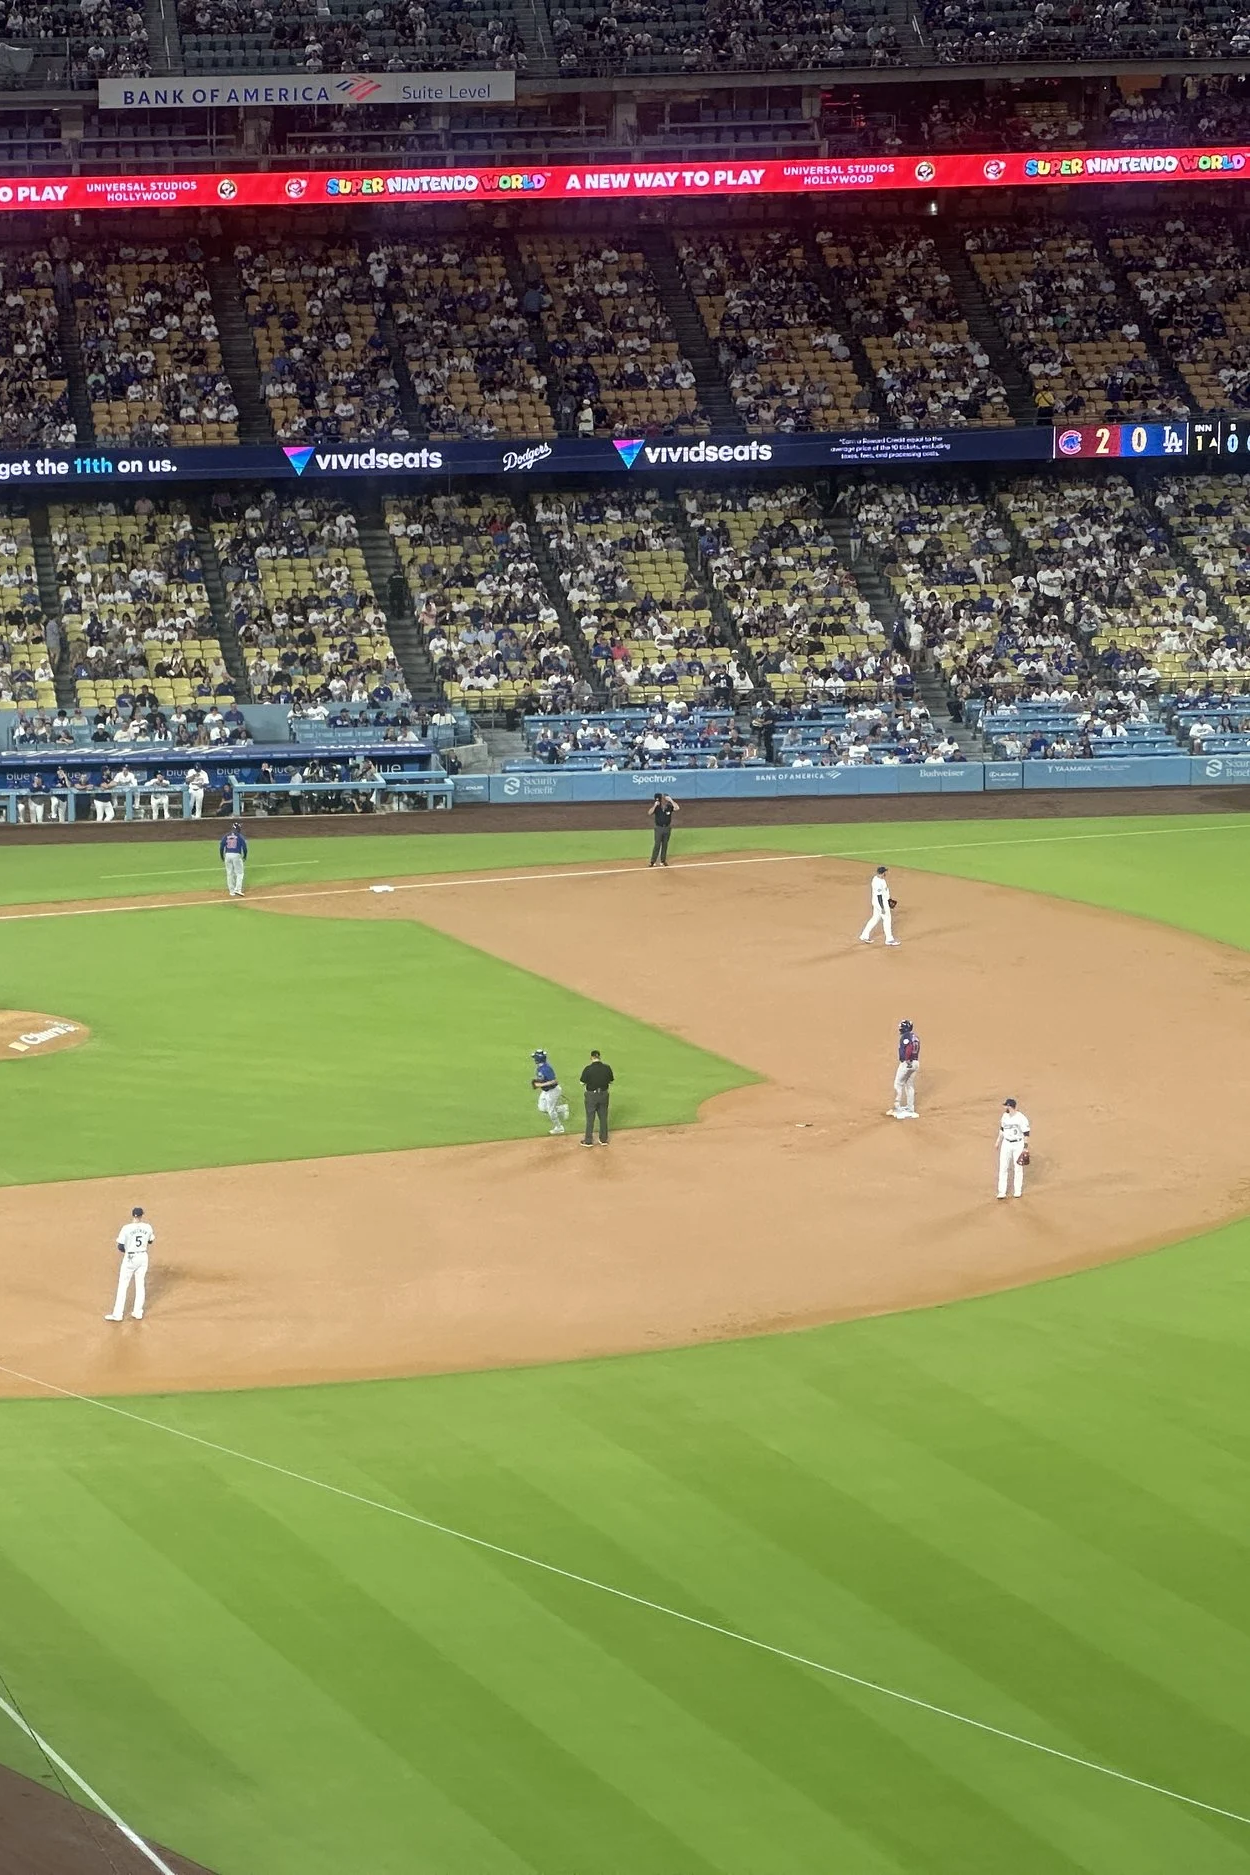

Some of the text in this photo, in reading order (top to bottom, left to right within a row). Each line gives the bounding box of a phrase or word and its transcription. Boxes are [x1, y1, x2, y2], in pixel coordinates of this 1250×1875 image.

[123, 86, 330, 105] BANK OF AMERICA
[402, 84, 490, 99] Suite Level
[783, 164, 895, 177] UNIVERSAL STUDIOS
[1024, 158, 1083, 177] SUPER
[1085, 155, 1178, 175] NINTENDO
[326, 177, 385, 196] SUPER
[387, 175, 479, 194] NINTENDO
[565, 168, 765, 189] A NEW WAY TO PLAY
[803, 174, 874, 185] HOLLYWOOD
[18, 185, 69, 201] PLAY
[86, 180, 197, 193] UNIVERSAL STUDIOS
[107, 191, 177, 201] HOLLYWOOD
[1194, 424, 1213, 433] INN
[1230, 423, 1237, 432] B
[1095, 428, 1111, 454] 2
[1131, 426, 1147, 453] 0
[1163, 425, 1183, 453] LA
[1195, 435, 1204, 451] 1
[1227, 433, 1239, 453] 0
[315, 447, 442, 470] vividseats
[502, 442, 552, 472] Dodgers
[644, 440, 773, 464] vividseats
[35, 457, 69, 475] the
[73, 456, 113, 474] 11th
[117, 459, 142, 474] on
[148, 457, 178, 473] us.
[6, 771, 30, 781] blue
[216, 767, 240, 776] blue
[789, 772, 825, 781] AMERICA
[919, 768, 964, 778] Budweiser
[523, 776, 558, 786] Security
[632, 774, 674, 785] Spectrum
[523, 785, 554, 795] Benefit
[135, 1235, 143, 1248] 5
